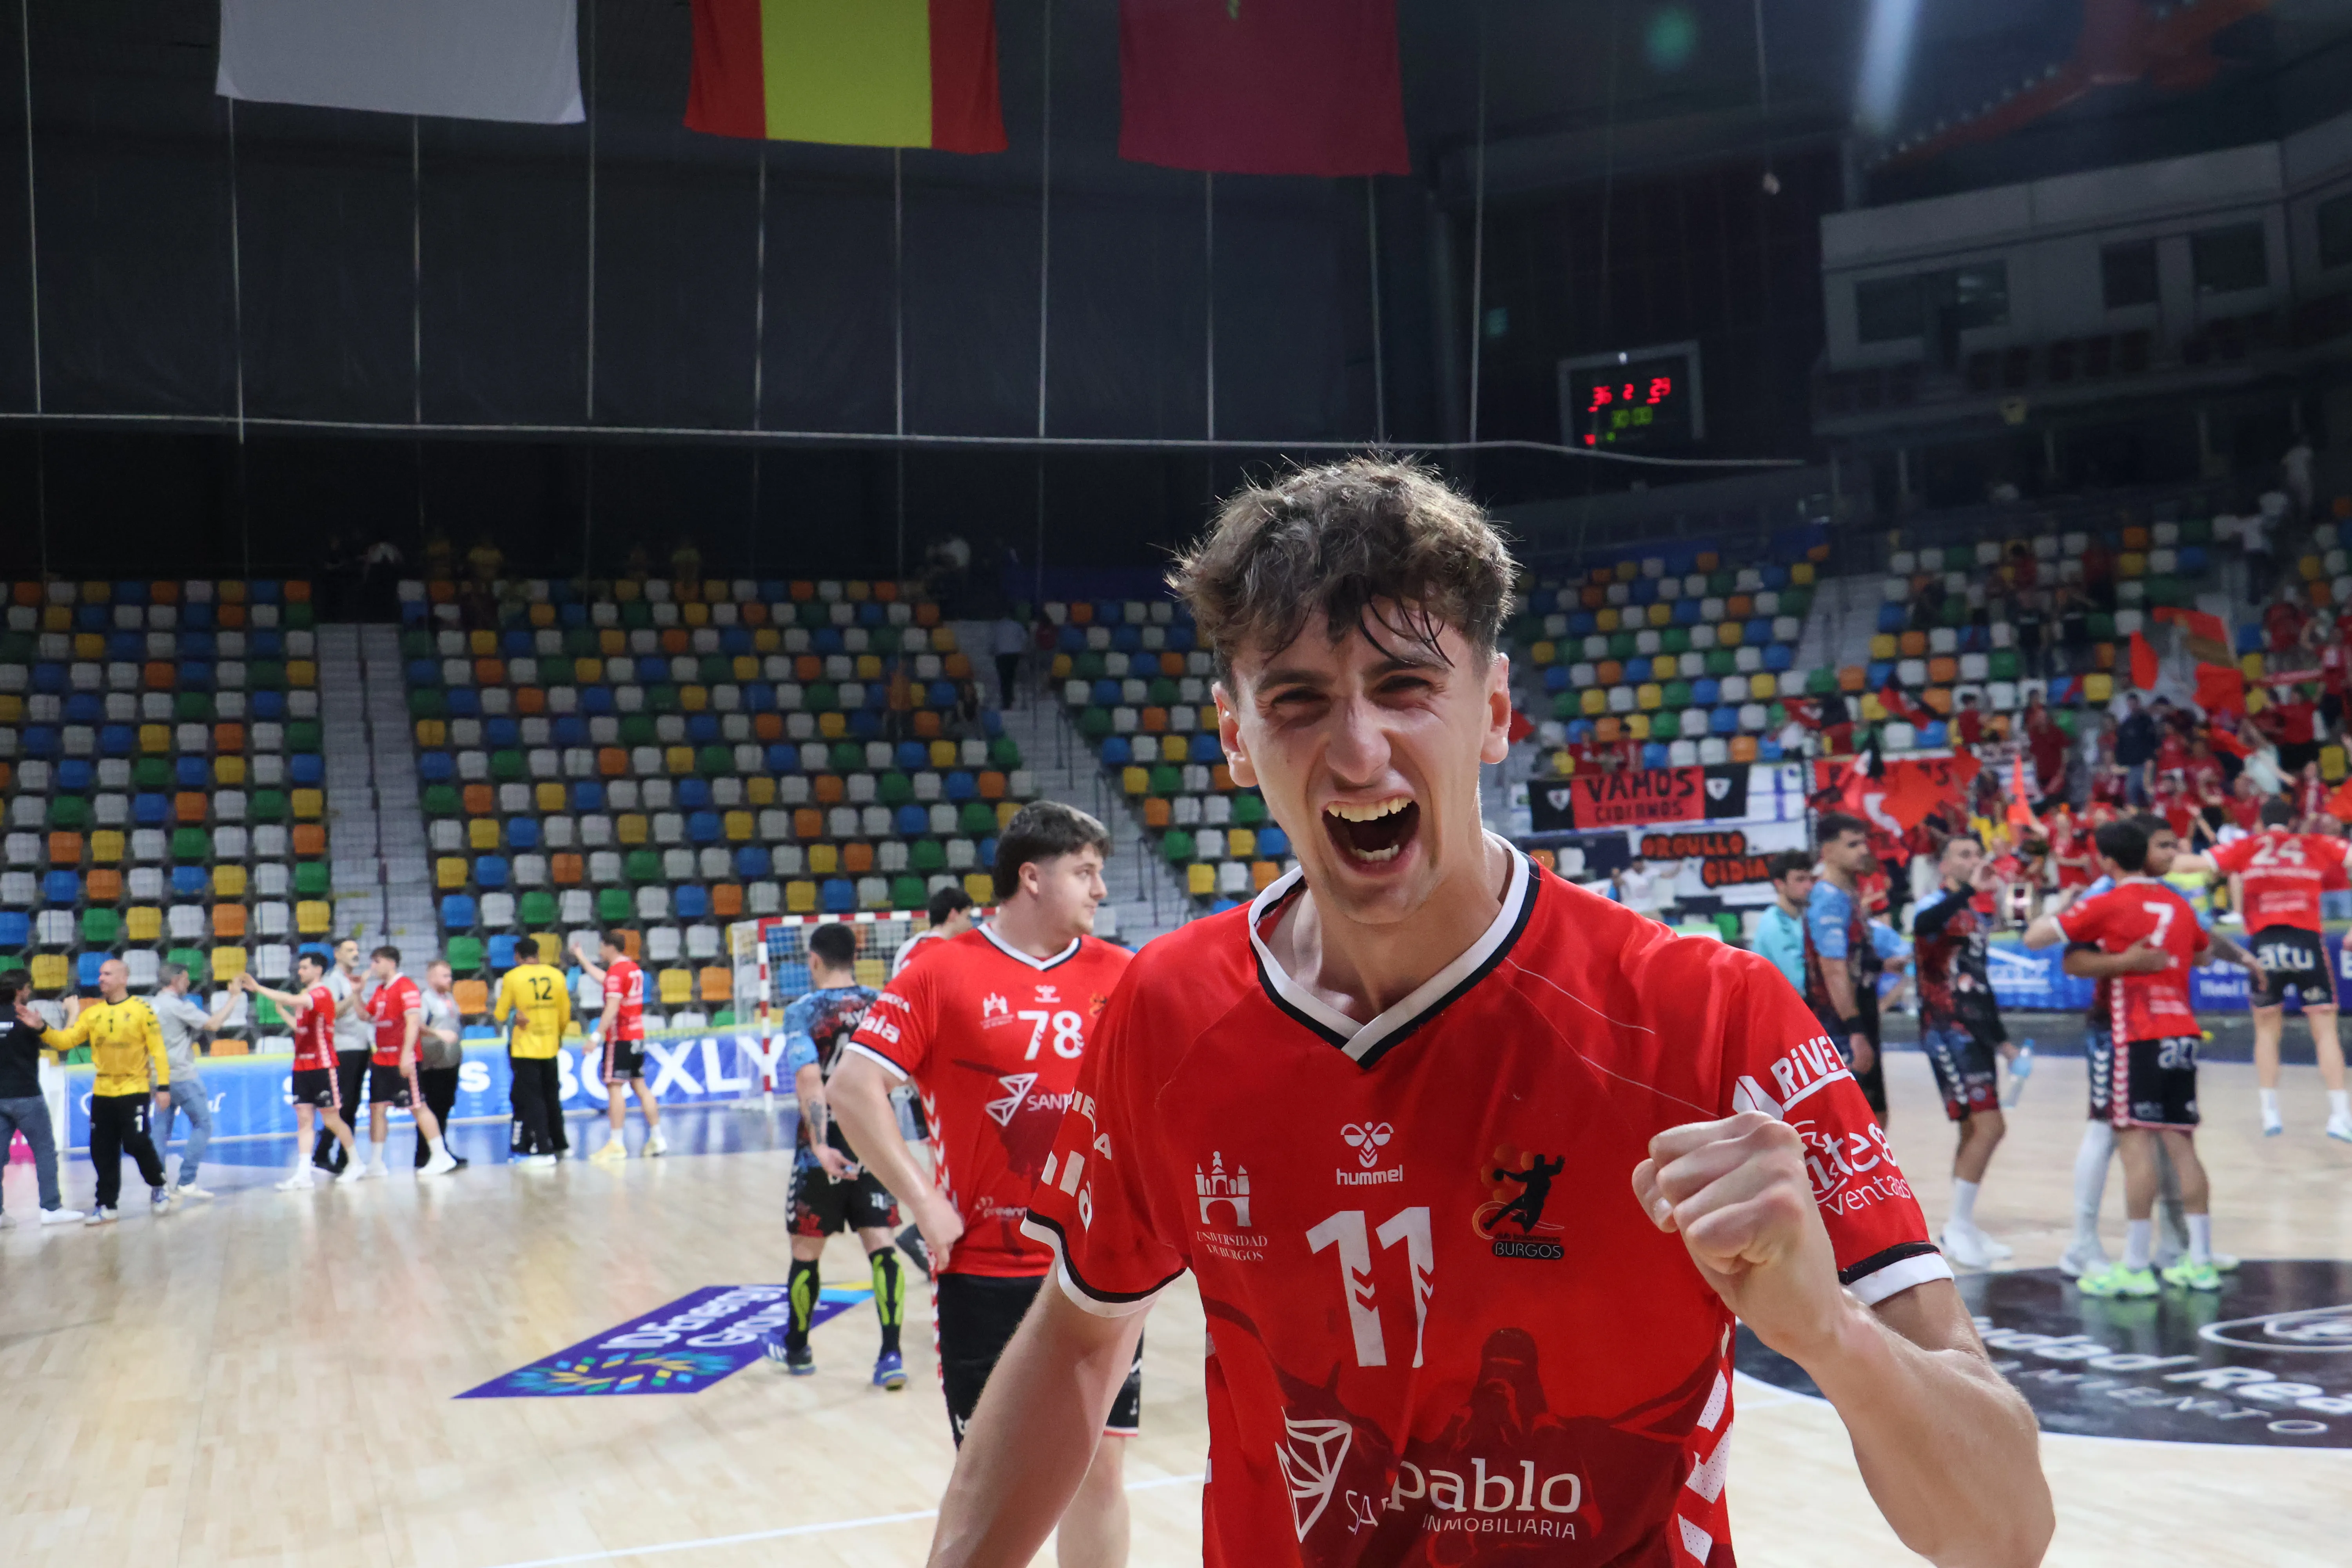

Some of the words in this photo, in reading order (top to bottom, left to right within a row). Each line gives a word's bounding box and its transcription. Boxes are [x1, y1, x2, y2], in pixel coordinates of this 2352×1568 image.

[1585, 768, 1695, 802] VAMOS
[1641, 830, 1746, 858] ORGULLO
[2251, 834, 2305, 865] 24
[1700, 855, 1780, 888] CIDIA
[2143, 901, 2174, 946] 7
[2257, 942, 2314, 971] atu
[528, 978, 552, 1000] 12
[1017, 1010, 1084, 1060] 78
[559, 1033, 786, 1100] BOXLY
[134, 1116, 144, 1132] 1
[1336, 1164, 1403, 1185] hummel
[1196, 1231, 1268, 1247] UNIVERSIDAD
[1495, 1242, 1561, 1258] BURGOS
[1220, 1247, 1263, 1261] BURGOS
[1305, 1206, 1434, 1368] 11
[1387, 1457, 1581, 1514] pablo
[1423, 1513, 1576, 1540] INMOBILIARIA
